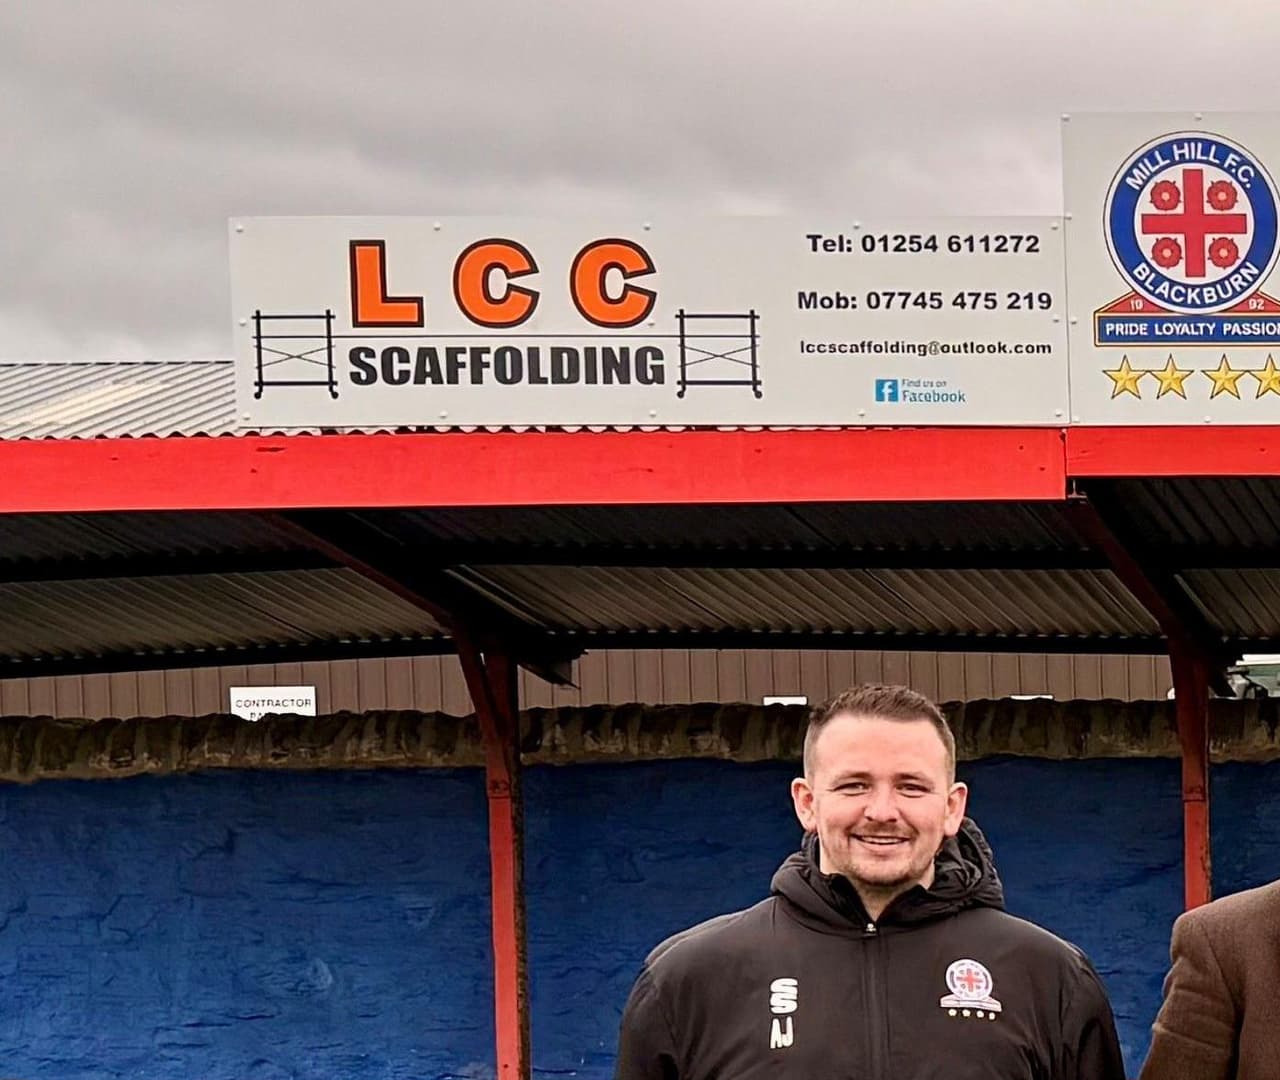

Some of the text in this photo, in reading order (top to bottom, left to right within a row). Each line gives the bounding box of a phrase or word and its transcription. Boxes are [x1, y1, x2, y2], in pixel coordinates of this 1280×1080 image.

[1126, 142, 1255, 190] MILL HILL F.C.
[807, 234, 1040, 253] Tel: 01254 611272
[1133, 261, 1259, 305] BLACKBURN
[798, 291, 1052, 311] Mob: 07745 475 219
[1106, 323, 1148, 336] PRIDE
[1154, 323, 1216, 336] LOYALTY
[801, 340, 1051, 357] lccscaffolding@outlook.com
[349, 345, 665, 386] SCAFFOLDING
[902, 390, 965, 402] Facebook
[235, 698, 311, 708] CONTRACTOR
